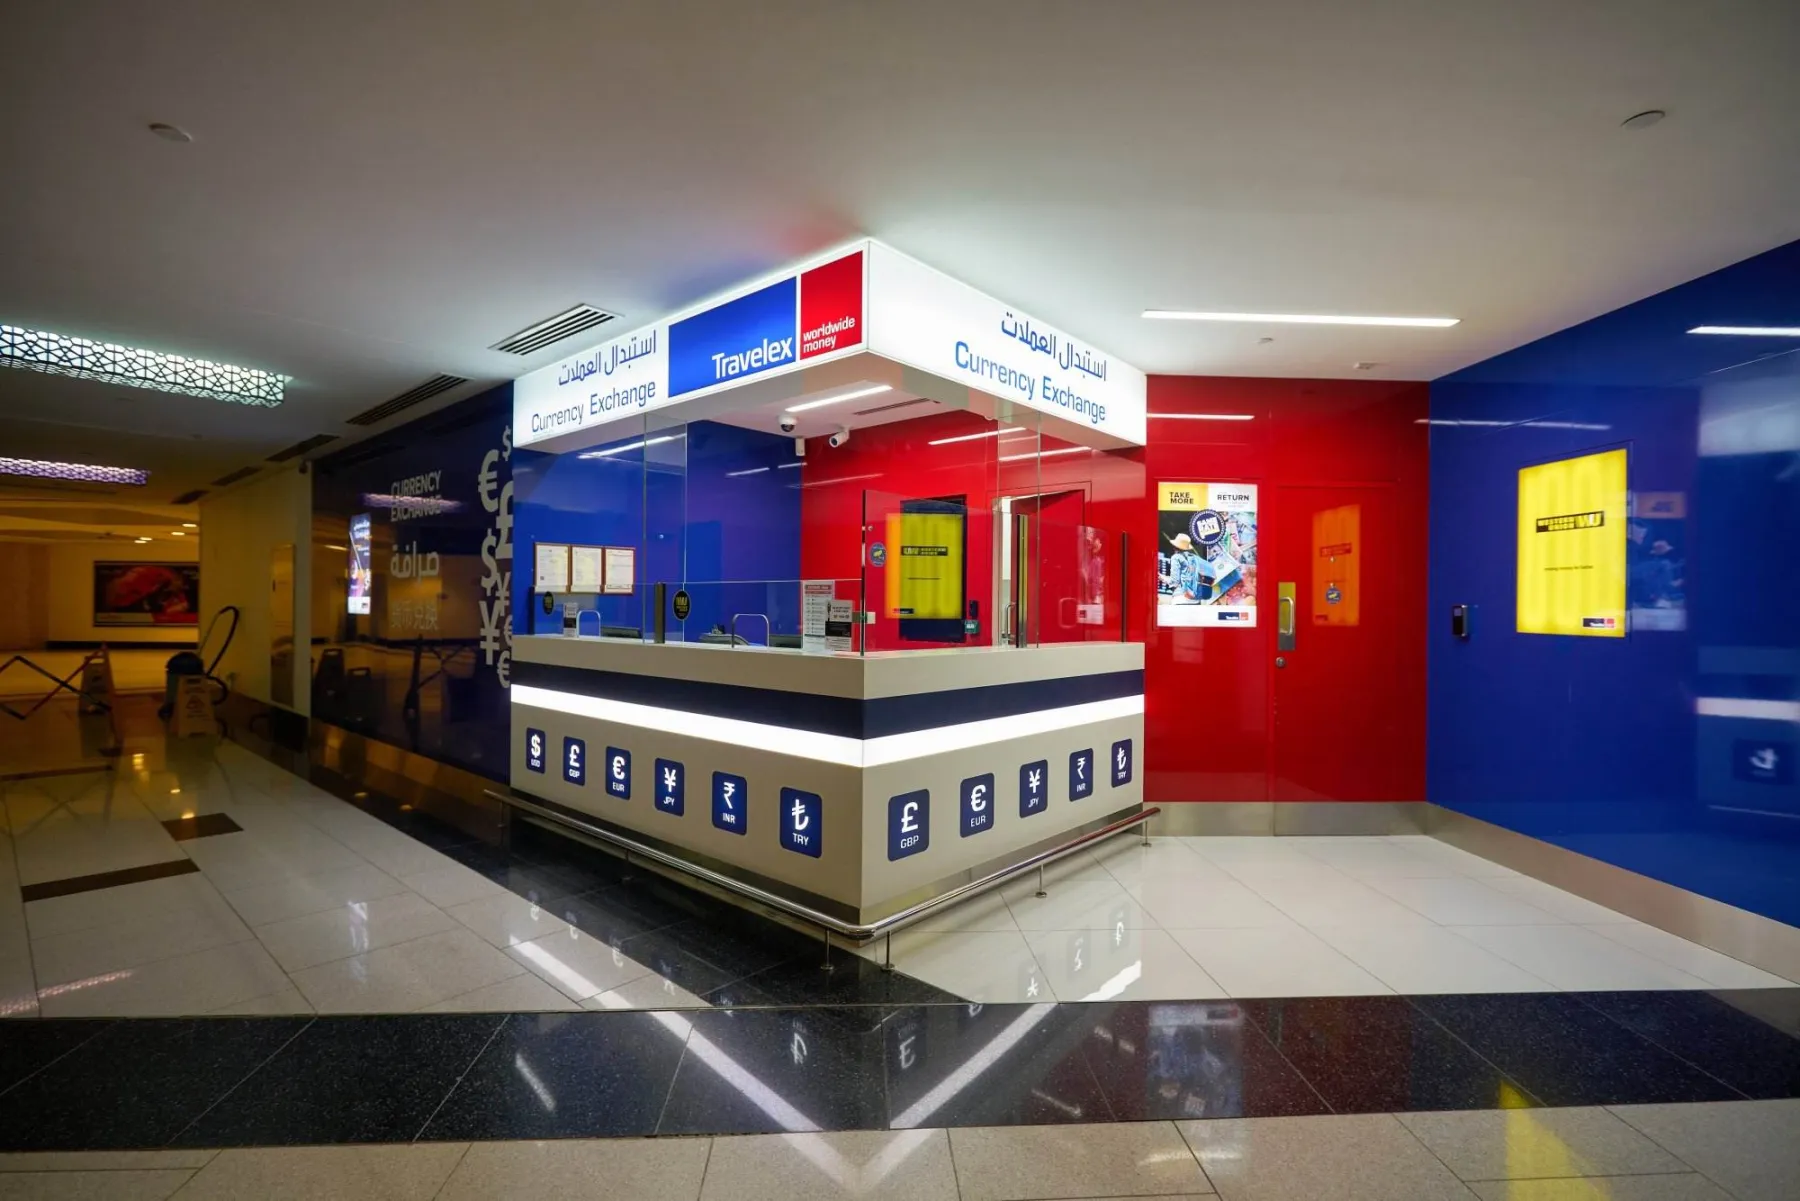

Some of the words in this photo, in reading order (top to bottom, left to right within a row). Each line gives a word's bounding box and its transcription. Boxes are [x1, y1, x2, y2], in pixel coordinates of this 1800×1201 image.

[803, 316, 856, 341] worldwide
[1001, 312, 1056, 359] العملات
[803, 335, 837, 354] money
[604, 330, 656, 376] استبدال
[711, 336, 793, 379] Travelex
[558, 354, 601, 386] العملات
[1058, 342, 1107, 382] استبدال
[955, 341, 1035, 401] Currency
[1042, 375, 1106, 424] Exchange
[531, 402, 584, 433] Currency
[590, 379, 656, 416] Exchange
[391, 469, 441, 500] CURRENCY
[1169, 491, 1190, 499] TAKE
[390, 541, 440, 585] صرافة
[569, 768, 580, 779] GBP
[1117, 770, 1127, 780] TRY
[613, 781, 625, 793] EUR
[1076, 783, 1086, 792] INR
[663, 796, 675, 806] JPY
[1028, 796, 1040, 808] JPY
[722, 812, 736, 824] INR
[970, 815, 986, 827] EUR
[792, 832, 809, 846] TRY
[900, 835, 919, 849] GBP
